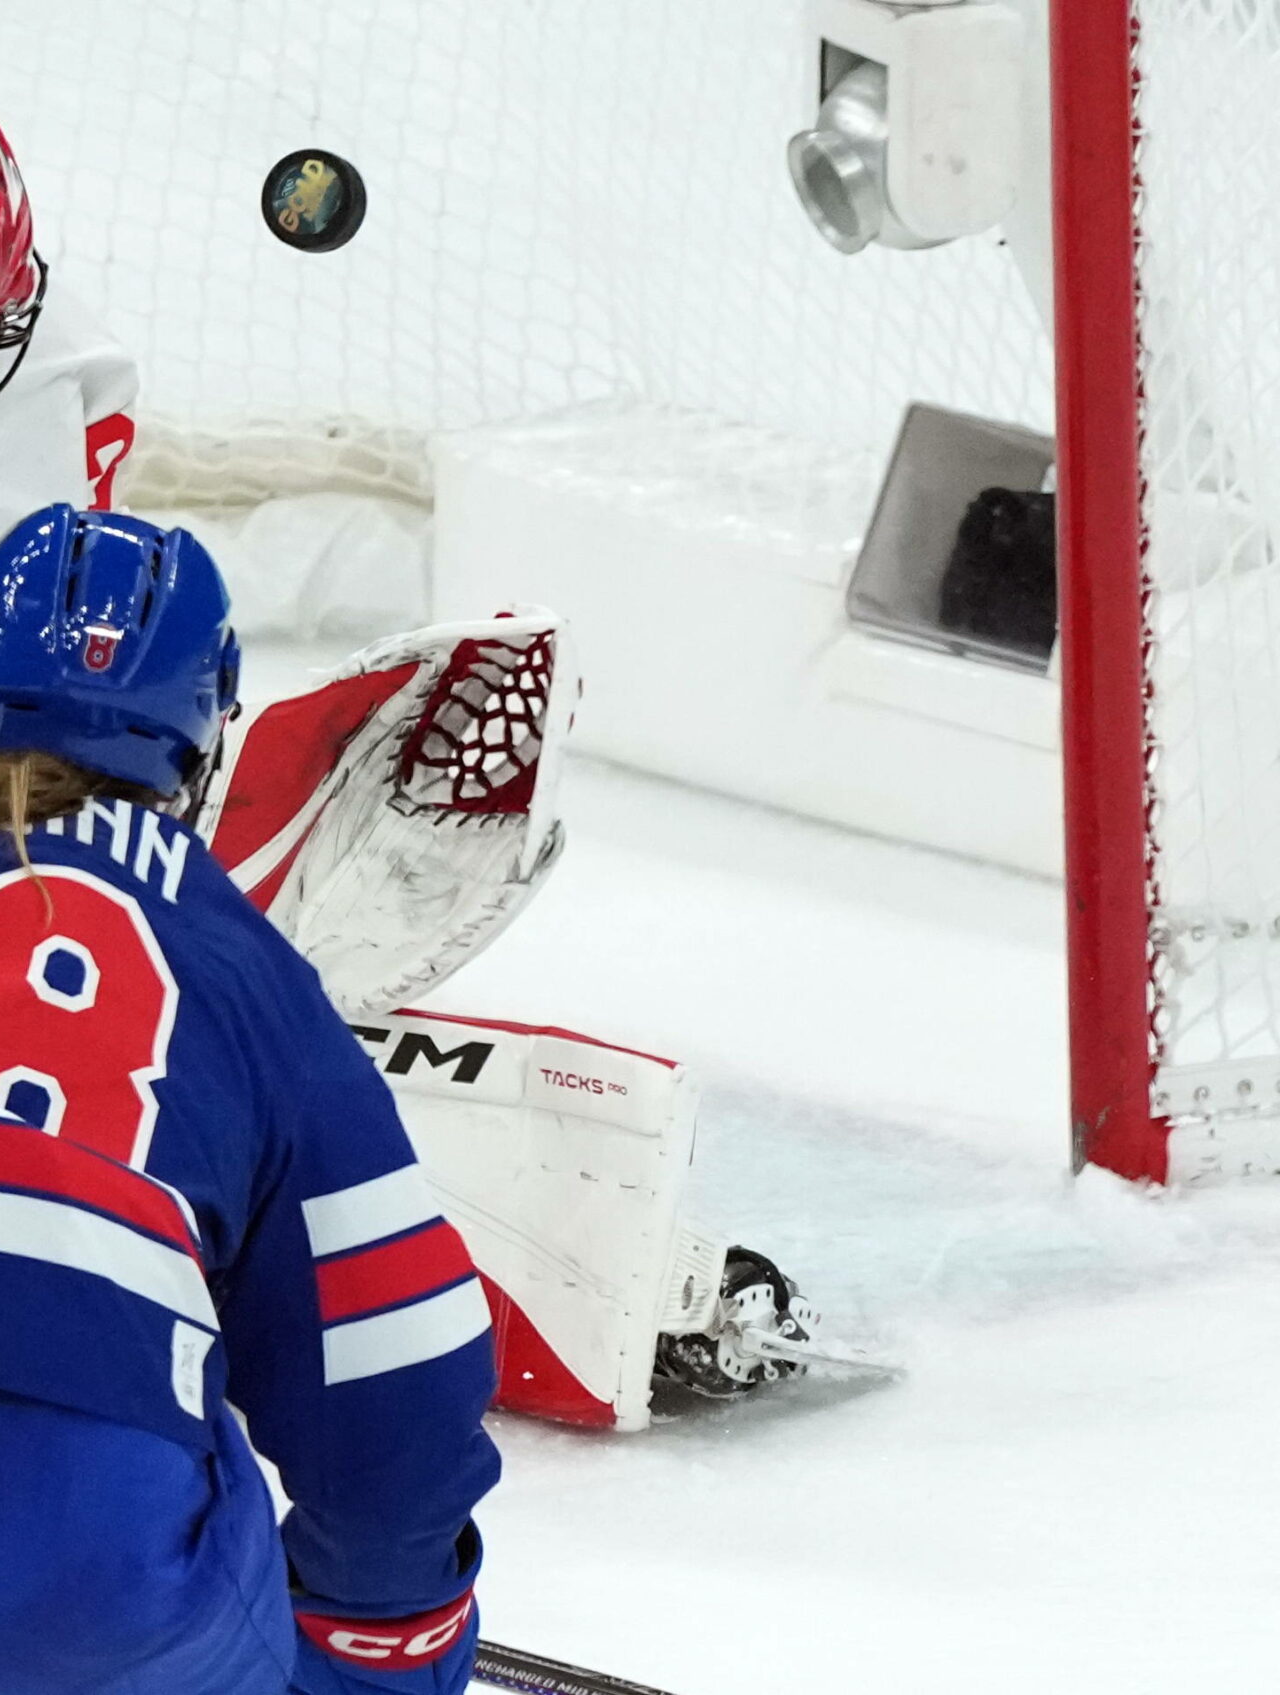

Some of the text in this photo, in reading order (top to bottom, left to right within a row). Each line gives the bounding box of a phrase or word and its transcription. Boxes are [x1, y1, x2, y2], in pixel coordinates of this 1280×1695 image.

[83, 622, 120, 674] 8
[540, 1068, 627, 1096] TACKS PRO
[327, 1598, 472, 1659] CC
